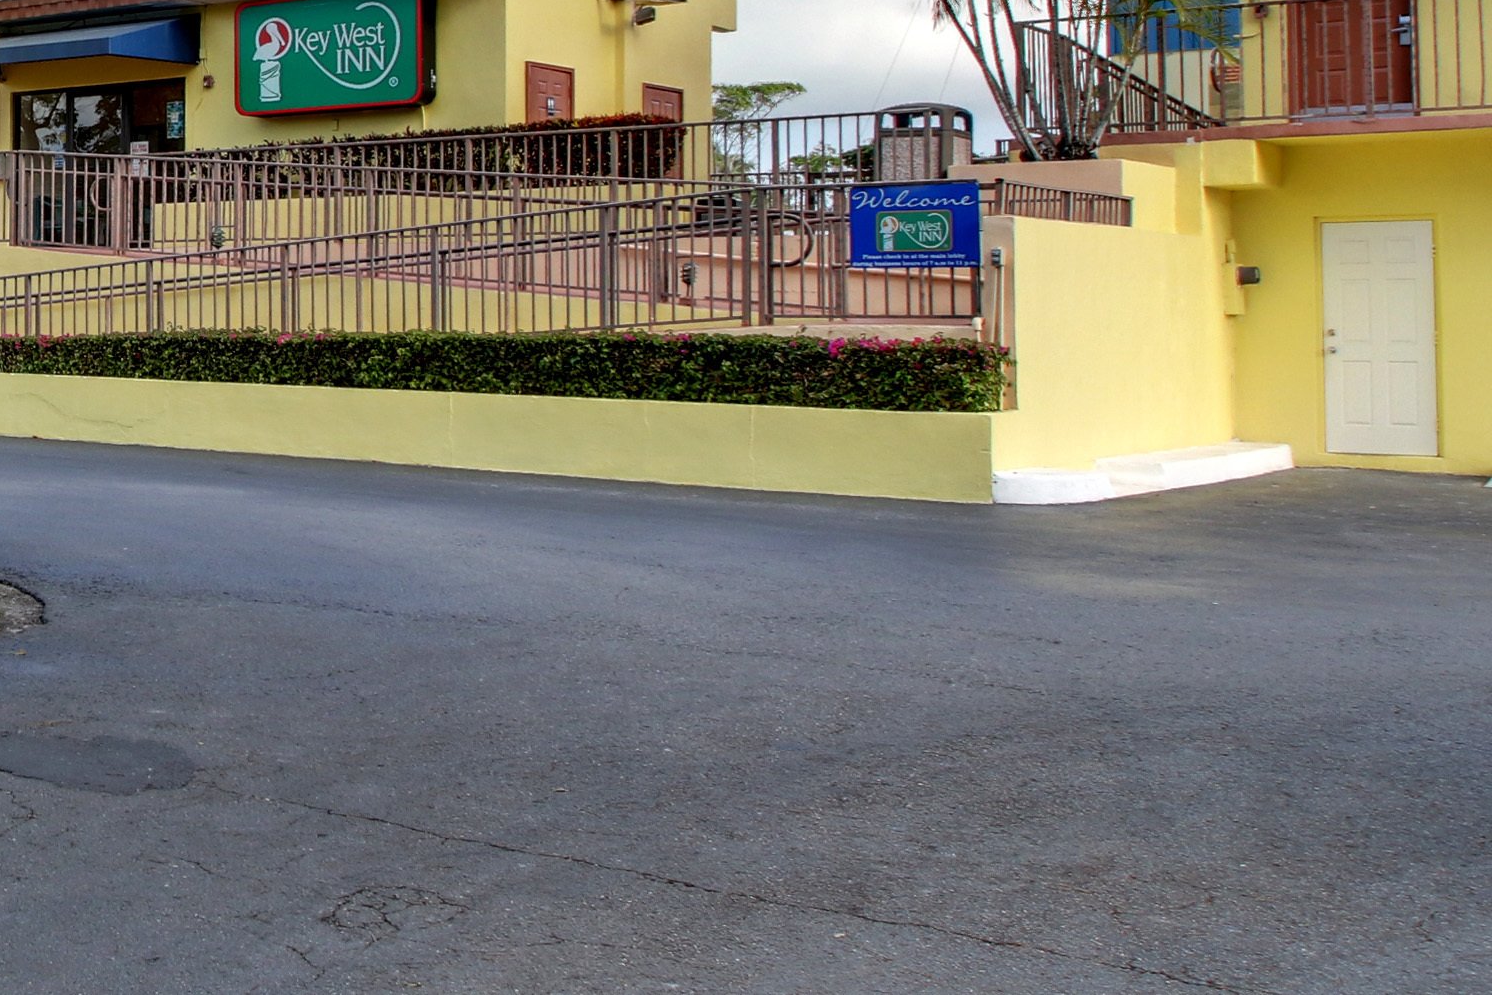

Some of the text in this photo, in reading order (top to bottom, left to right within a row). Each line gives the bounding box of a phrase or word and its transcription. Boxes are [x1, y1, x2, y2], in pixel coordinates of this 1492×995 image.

[294, 21, 386, 56] Key West
[335, 45, 386, 75] INN
[851, 188, 977, 210] Welcome
[899, 220, 941, 234] Key West
[919, 230, 942, 243] INN
